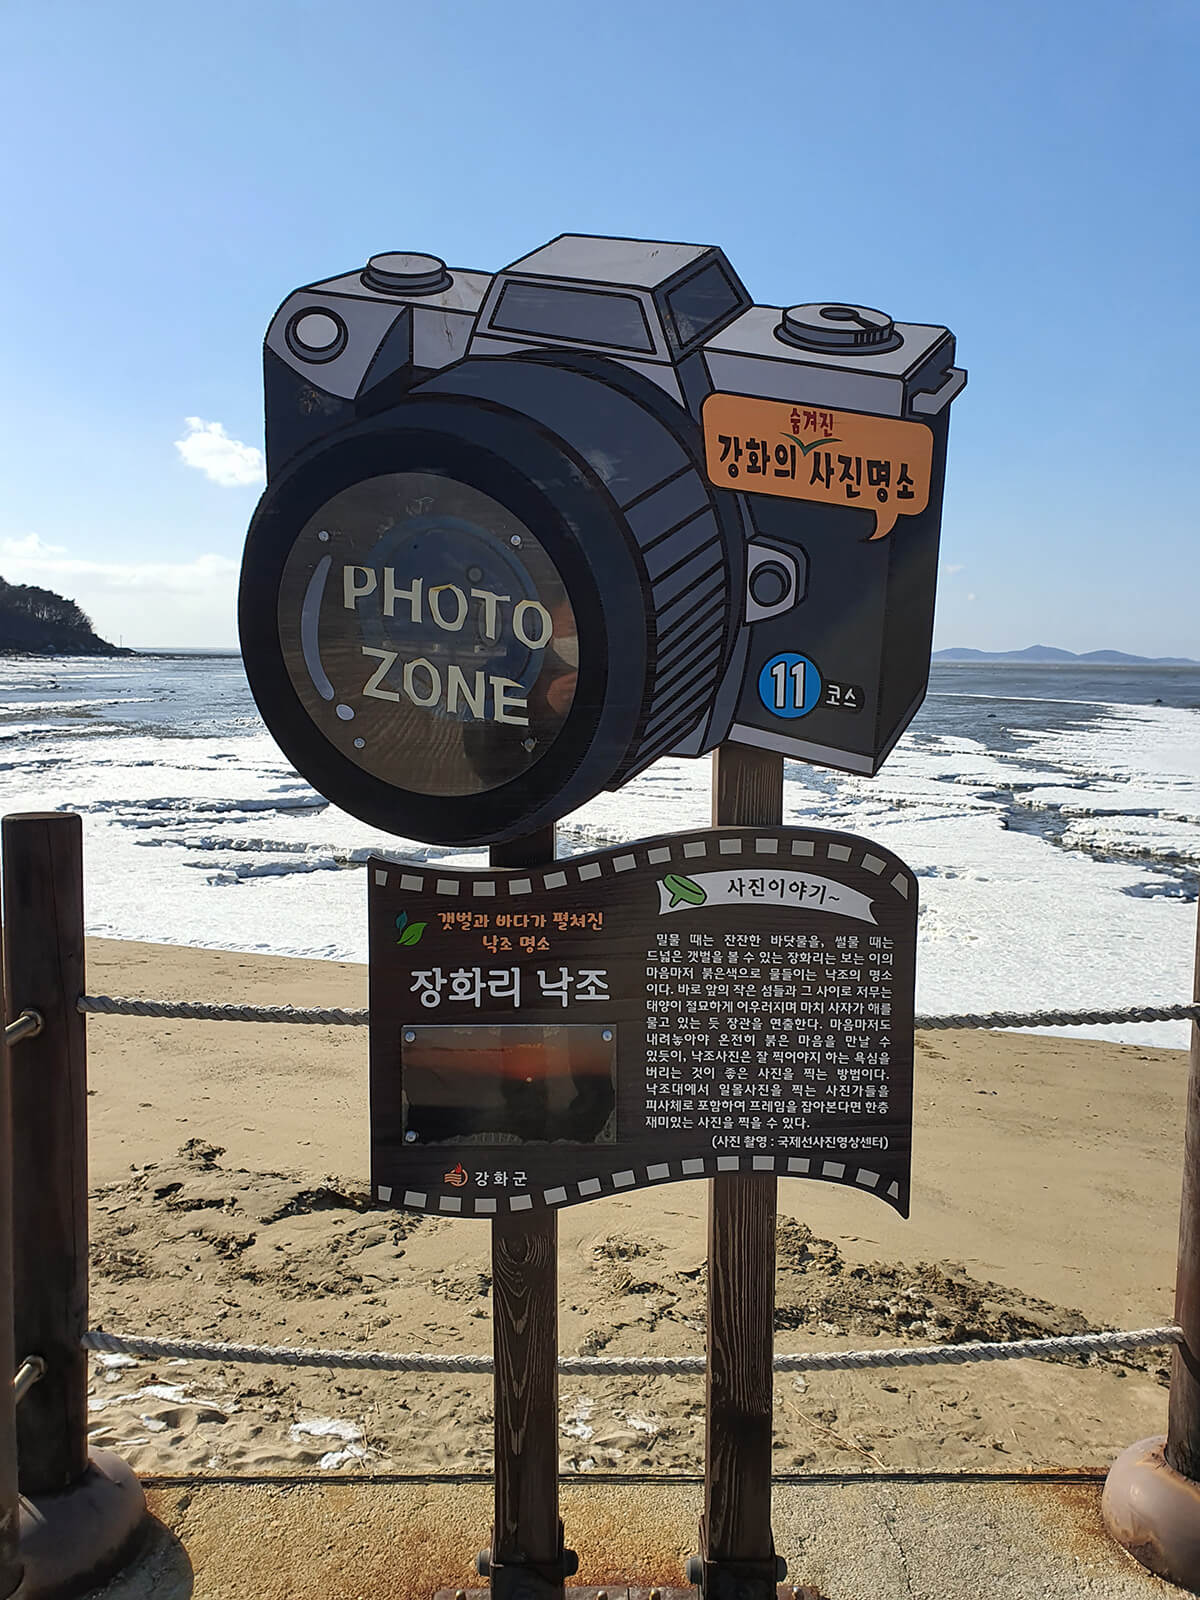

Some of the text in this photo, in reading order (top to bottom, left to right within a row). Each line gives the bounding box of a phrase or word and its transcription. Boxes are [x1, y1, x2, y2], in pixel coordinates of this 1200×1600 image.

[790, 408, 834, 437] 숨겨진
[718, 434, 915, 503] 강화의 사진명소
[344, 565, 553, 650] PHOTO
[361, 646, 529, 726] ZONE
[772, 662, 856, 708] 11 코스
[728, 878, 840, 905] 사진이야기~
[437, 912, 603, 931] 갯벌과 바다가 펼쳐진
[482, 935, 550, 954] 낙조 명소
[657, 934, 893, 949] 밀물 때는 잔잔한 바닷물을, 썰물 때는
[688, 951, 723, 963] 갯벌을
[728, 951, 739, 963] 볼
[743, 952, 754, 963] 수
[760, 952, 783, 964] 있는
[788, 952, 836, 965] 장화리는
[840, 953, 864, 965] 보는
[869, 953, 892, 965] 이의
[647, 967, 892, 982] 마음마저 붉은색으로 물들이는 낙조의 명소
[410, 967, 610, 1008] 장화리 낙조
[647, 984, 892, 998] 이다. 바로 앞의 작은 섬들과 그 사이로 저무는
[647, 1000, 891, 1015] 태양이 절묘하게 어우러지며 마치 사자가 해를
[646, 1017, 891, 1031] 물고 있는 듯 장관을 연출한다. 마음마저도
[647, 1033, 891, 1048] 내려놓아야 온전히 붉은 마음을 만날 수
[647, 1050, 890, 1064] 있듯이, 낙조사진은 잘 찍어야지 하는 욕심을
[646, 1067, 889, 1081] 버리는 것이 좋은 사진을 찍는 방법이다.
[647, 1083, 889, 1097] 낙조대에서 일몰사진을 찍는 사진가들을
[646, 1100, 888, 1114] 피사체로 포함하여 프레임을 잡아본다면 한층
[646, 1116, 809, 1129] 재미있는 사진을 찍을 수 있다.
[712, 1135, 740, 1149] (사진
[744, 1136, 766, 1148] 촬영
[778, 1136, 888, 1149] 국제선사진영상센터)
